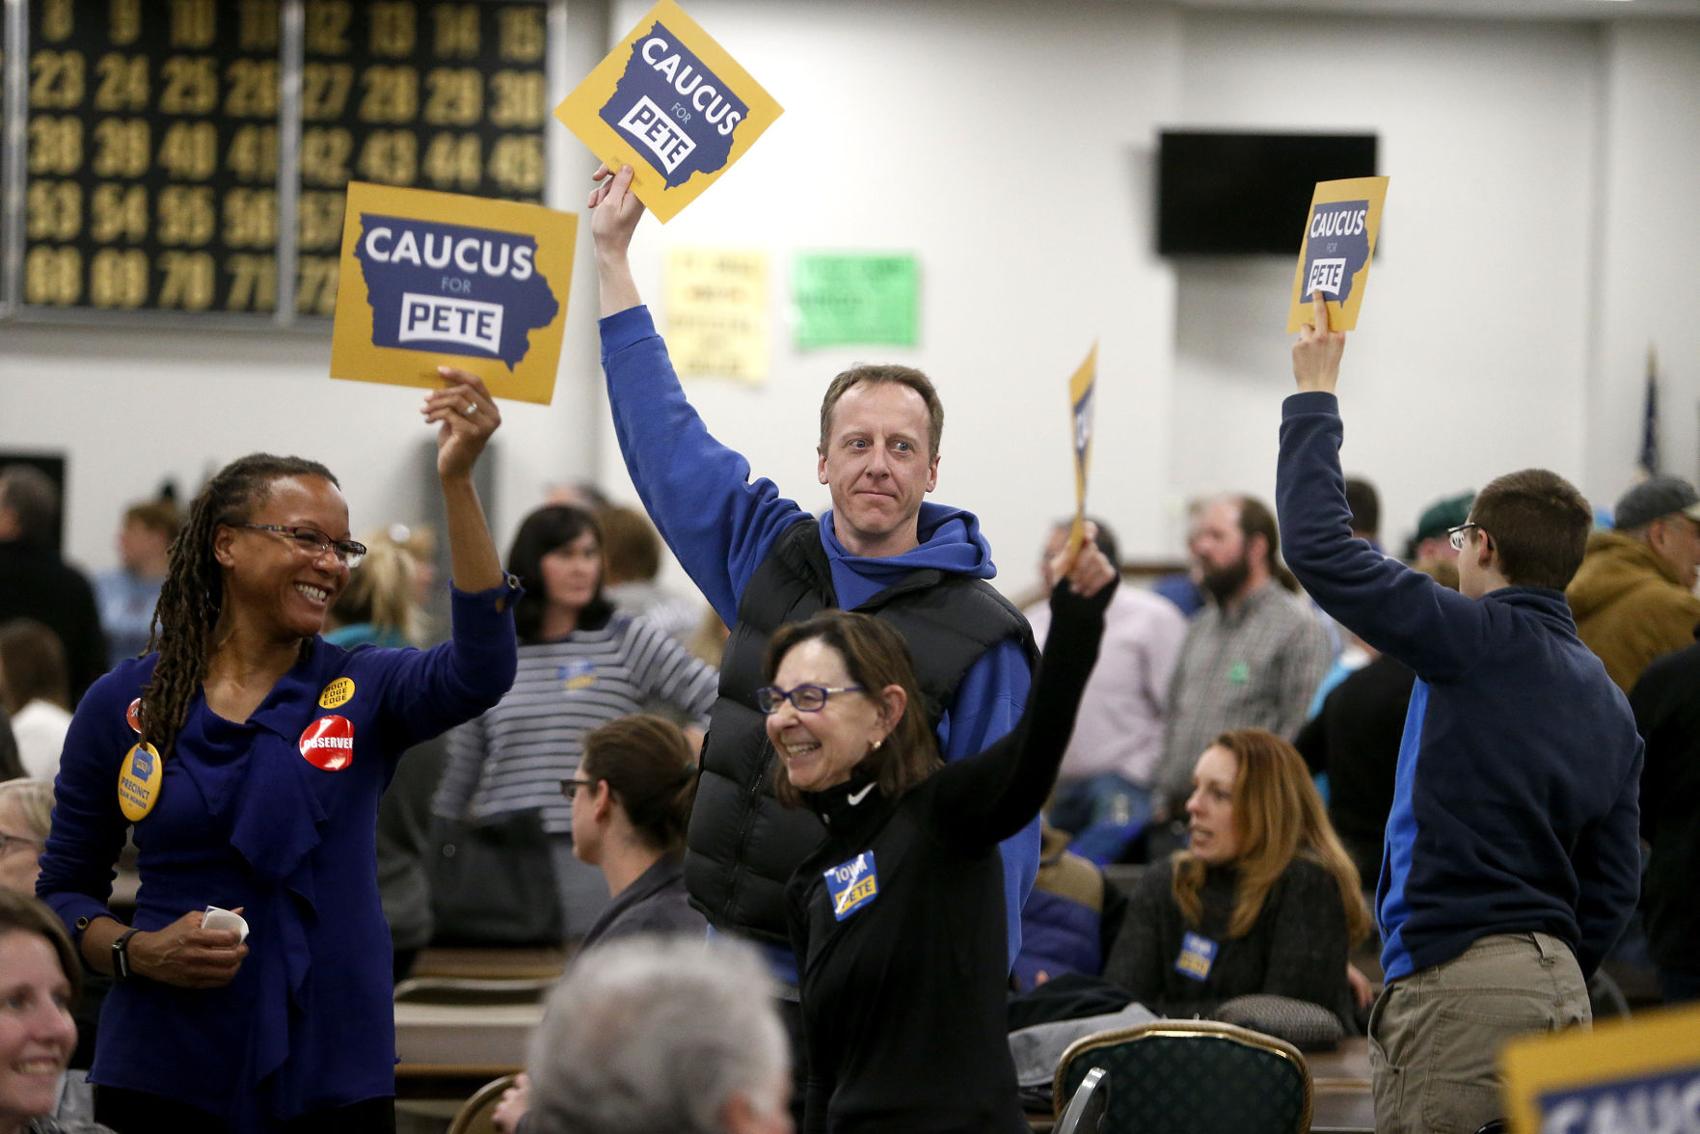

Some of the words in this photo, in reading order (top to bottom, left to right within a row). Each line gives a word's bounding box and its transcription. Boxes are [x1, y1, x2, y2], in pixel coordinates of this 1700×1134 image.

[642, 37, 741, 135] CAUCUS
[670, 102, 691, 125] FOR
[629, 104, 689, 164] PETE
[1310, 210, 1366, 238] CAUCUS
[365, 227, 533, 280] CAUCUS
[441, 276, 472, 293] FOR
[1310, 264, 1342, 288] PETE
[408, 302, 496, 341] PETE
[323, 695, 346, 706] EDGE
[121, 776, 150, 801] PRECINCT
[836, 855, 868, 883] IOWA
